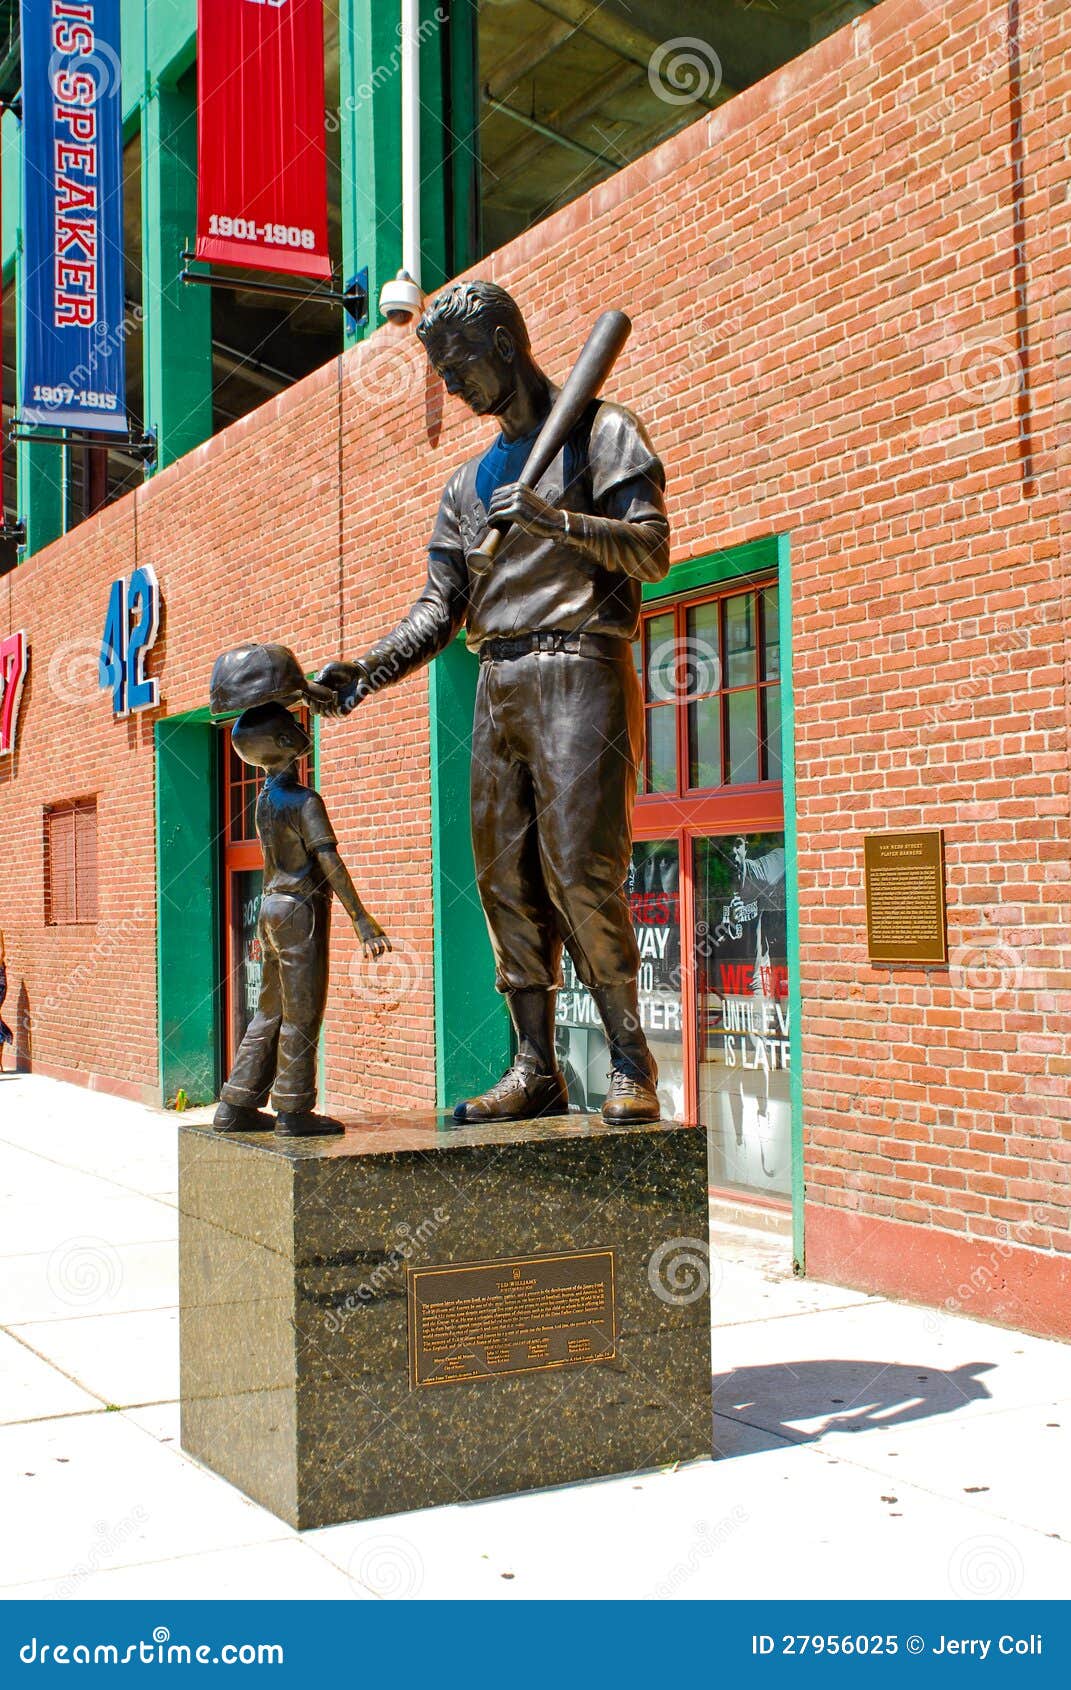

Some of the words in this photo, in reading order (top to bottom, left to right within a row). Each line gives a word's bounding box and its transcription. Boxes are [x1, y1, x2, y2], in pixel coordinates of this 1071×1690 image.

[54, 70, 98, 329] SPEAKER
[208, 214, 315, 250] 1901-1908
[33, 385, 118, 410] 1907-1915
[98, 563, 160, 718] 42
[720, 964, 755, 996] WE
[722, 999, 756, 1033] UNTIL
[724, 1035, 736, 1067] IS
